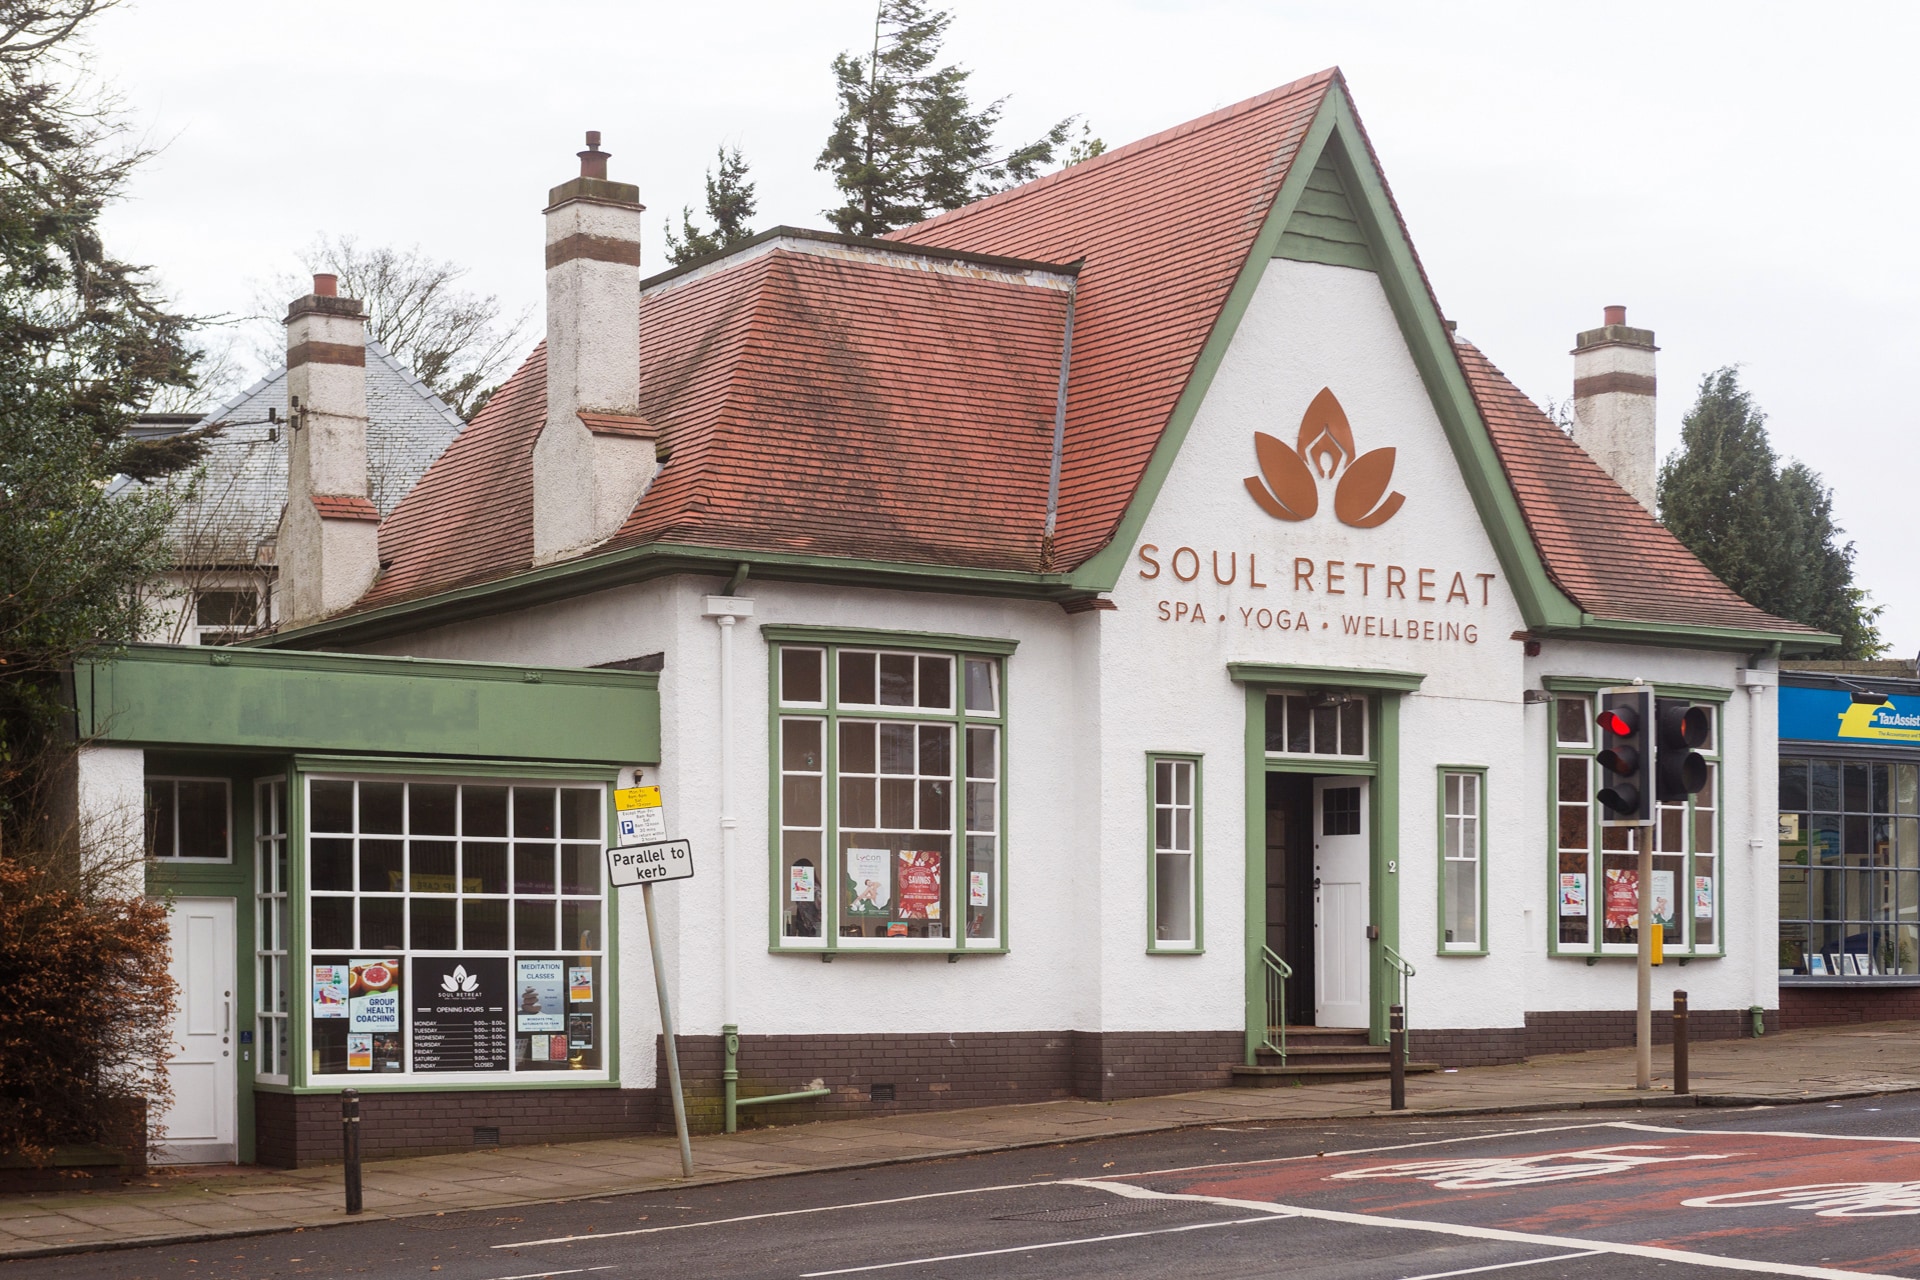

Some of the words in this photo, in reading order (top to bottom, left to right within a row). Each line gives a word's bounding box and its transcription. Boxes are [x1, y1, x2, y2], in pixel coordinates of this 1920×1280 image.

[1139, 543, 1267, 589] SOUL
[1294, 557, 1496, 606] RETREAT
[1158, 600, 1206, 624] SPA
[1239, 606, 1310, 631] YOGA
[1341, 614, 1479, 644] WELLBEING
[612, 848, 665, 867] Parallel
[670, 847, 685, 860] to
[636, 864, 667, 880] kerb
[1388, 860, 1397, 873] 2
[369, 998, 395, 1006] GROUP
[366, 1006, 395, 1014] HEALTH
[356, 1014, 395, 1023] COACHING
